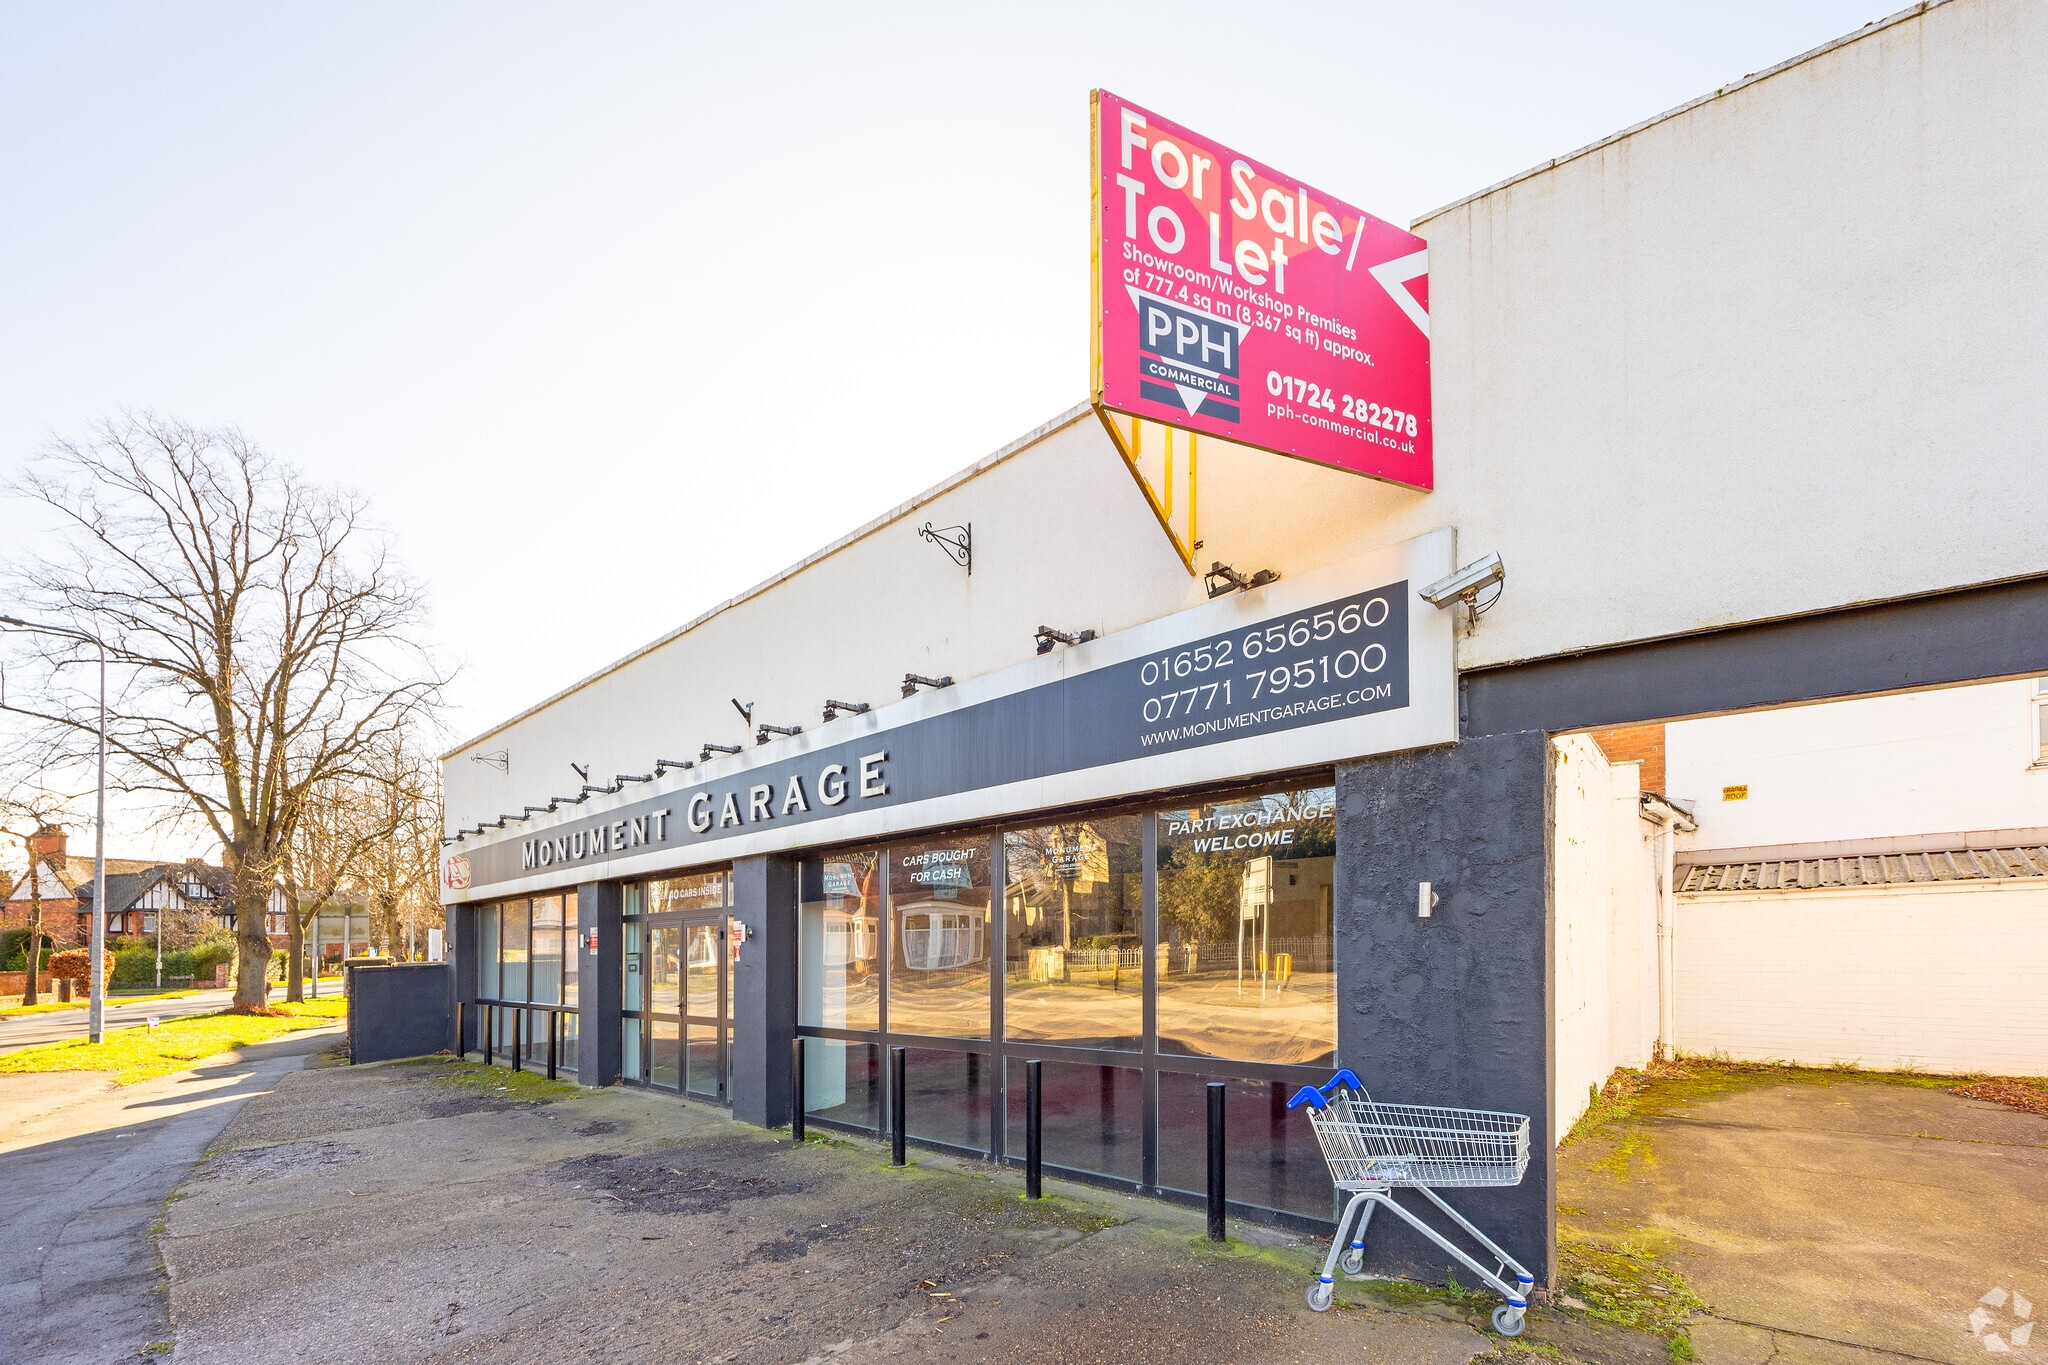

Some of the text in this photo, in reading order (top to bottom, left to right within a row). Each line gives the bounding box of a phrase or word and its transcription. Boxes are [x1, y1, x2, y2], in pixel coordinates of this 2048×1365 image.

[1121, 106, 1211, 200] For
[1116, 172, 1186, 254] To
[1209, 212, 1288, 294] Let
[1123, 241, 1357, 340] Showroom/Workshop Premises
[1123, 268, 1375, 367] of 777.4 sq m (8,367 sq ft) approx.
[1148, 306, 1231, 370] PPH
[1149, 363, 1232, 395] COMMERCIAL
[1266, 370, 1418, 438] 01724 282278
[1267, 402, 1415, 455] pph-commercial.co.uk
[1141, 597, 1389, 686] 01652 656560
[1143, 643, 1387, 722] 07771 795100
[1141, 683, 1392, 747] WWW.MONUMENTGARAGE.COM
[522, 750, 888, 870] MONUMENT GARAGE
[1168, 803, 1334, 836] PART EXCHANGE
[1194, 829, 1295, 854] WELCOME
[902, 848, 976, 866] CARS BOUGHT
[910, 868, 961, 883] FOR CASH
[1052, 854, 1090, 864] GARAGE
[679, 887, 697, 898] CARS
